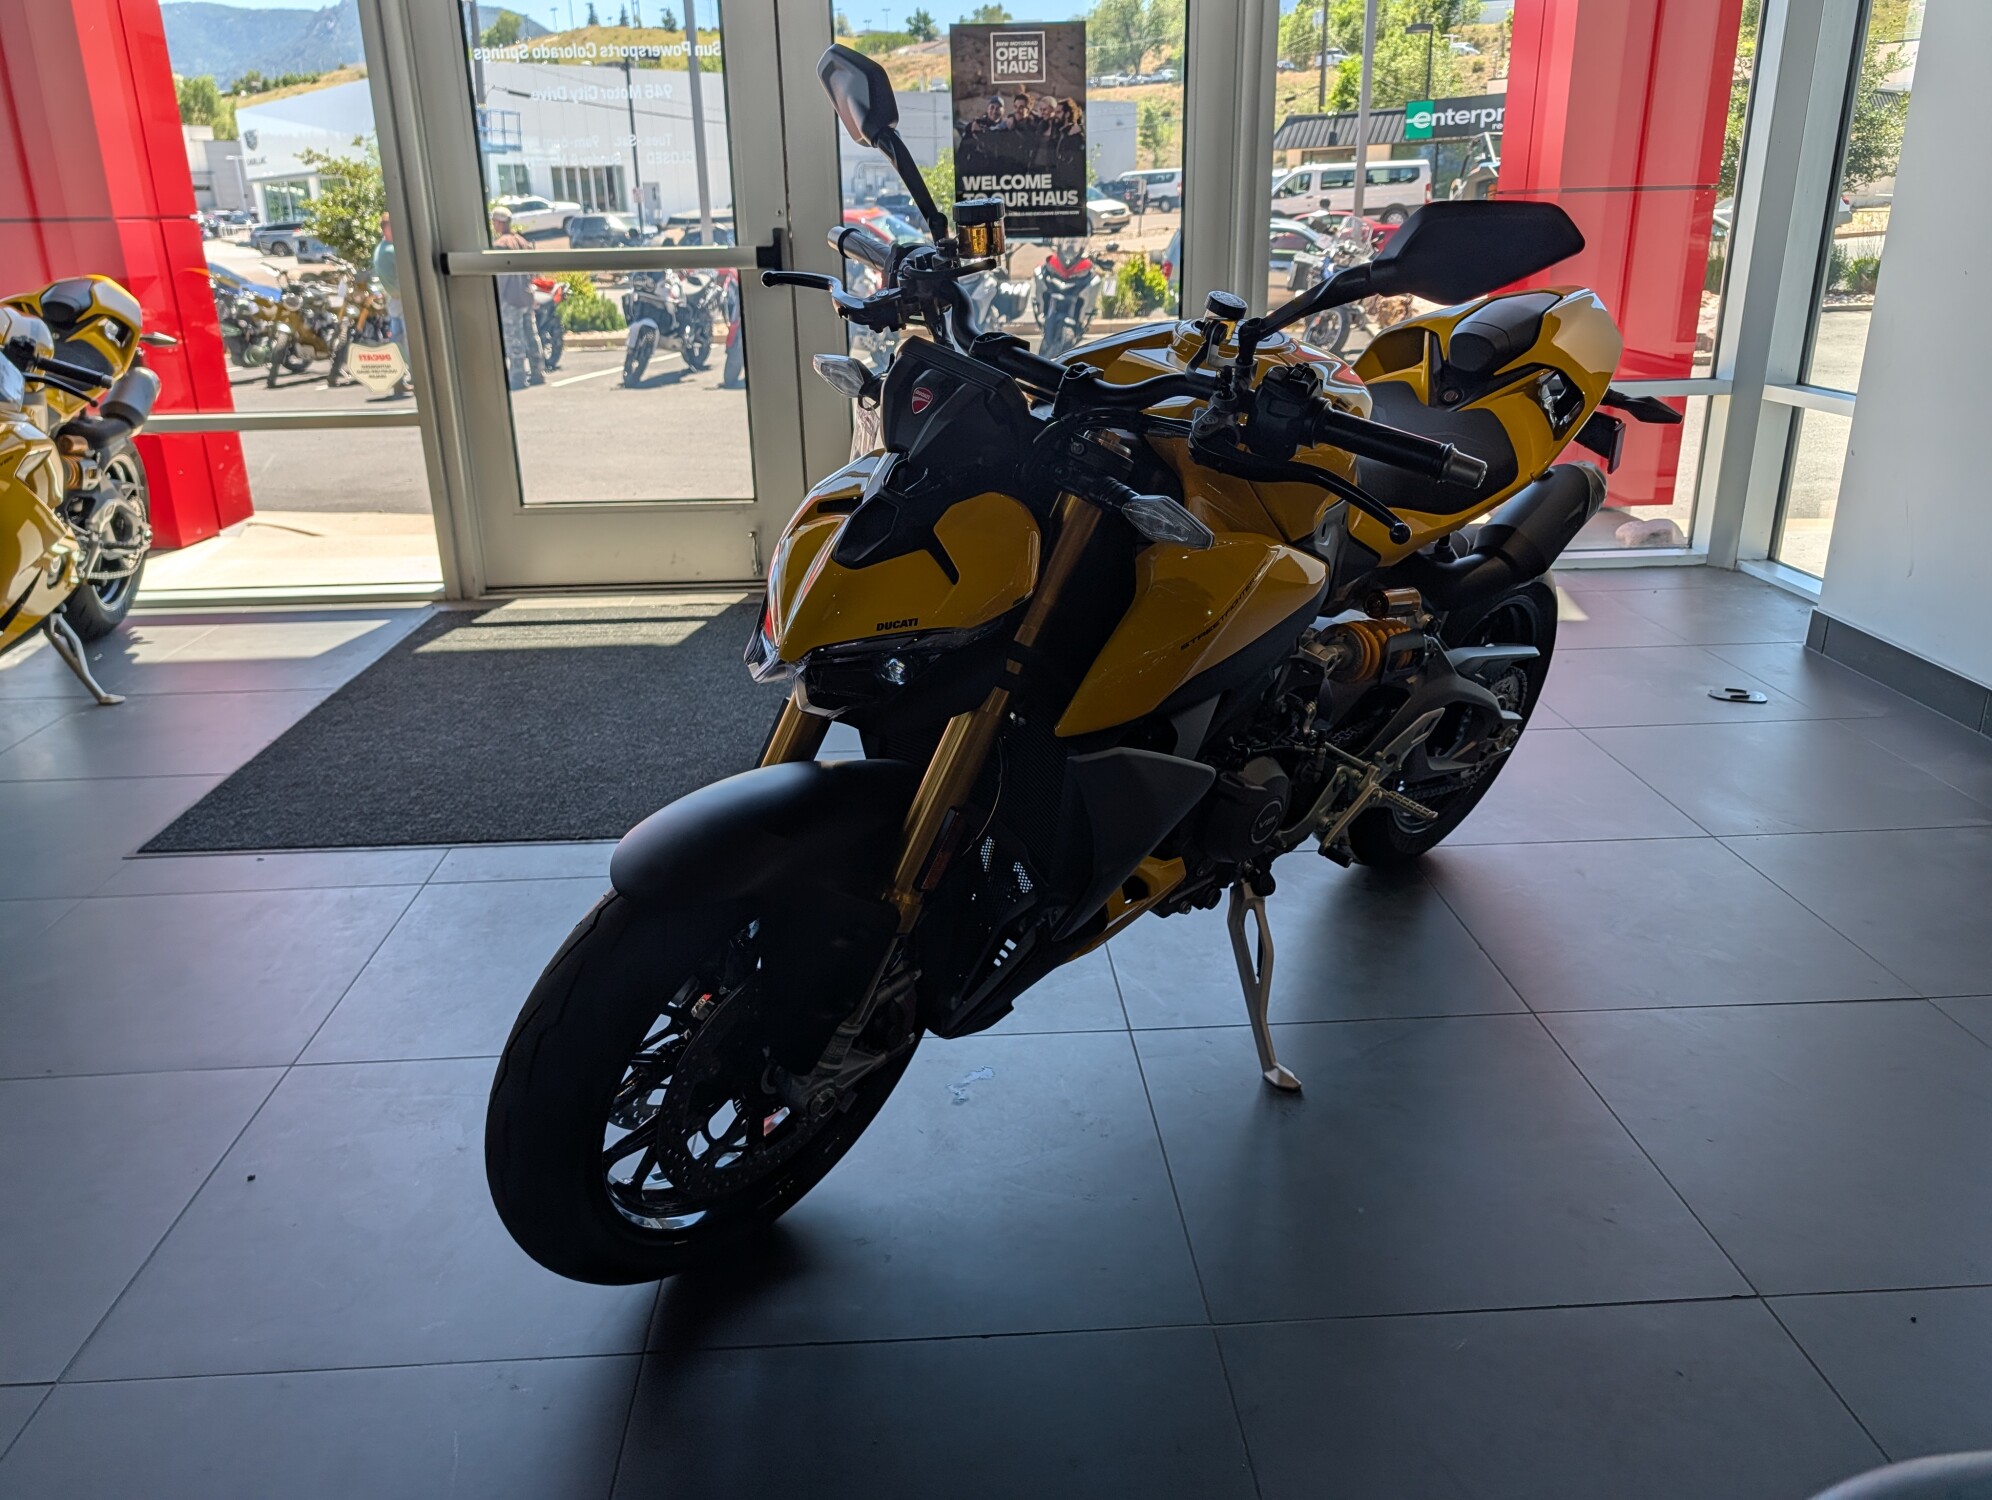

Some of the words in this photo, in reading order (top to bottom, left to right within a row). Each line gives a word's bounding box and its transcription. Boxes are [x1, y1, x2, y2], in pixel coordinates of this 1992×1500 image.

[995, 46, 1039, 61] OPEN
[996, 60, 1039, 74] HAUS
[1406, 107, 1505, 129] enterpr
[962, 174, 1053, 192] WELCOME
[1032, 190, 1079, 207] HAUS
[876, 617, 919, 631] DUCATI
